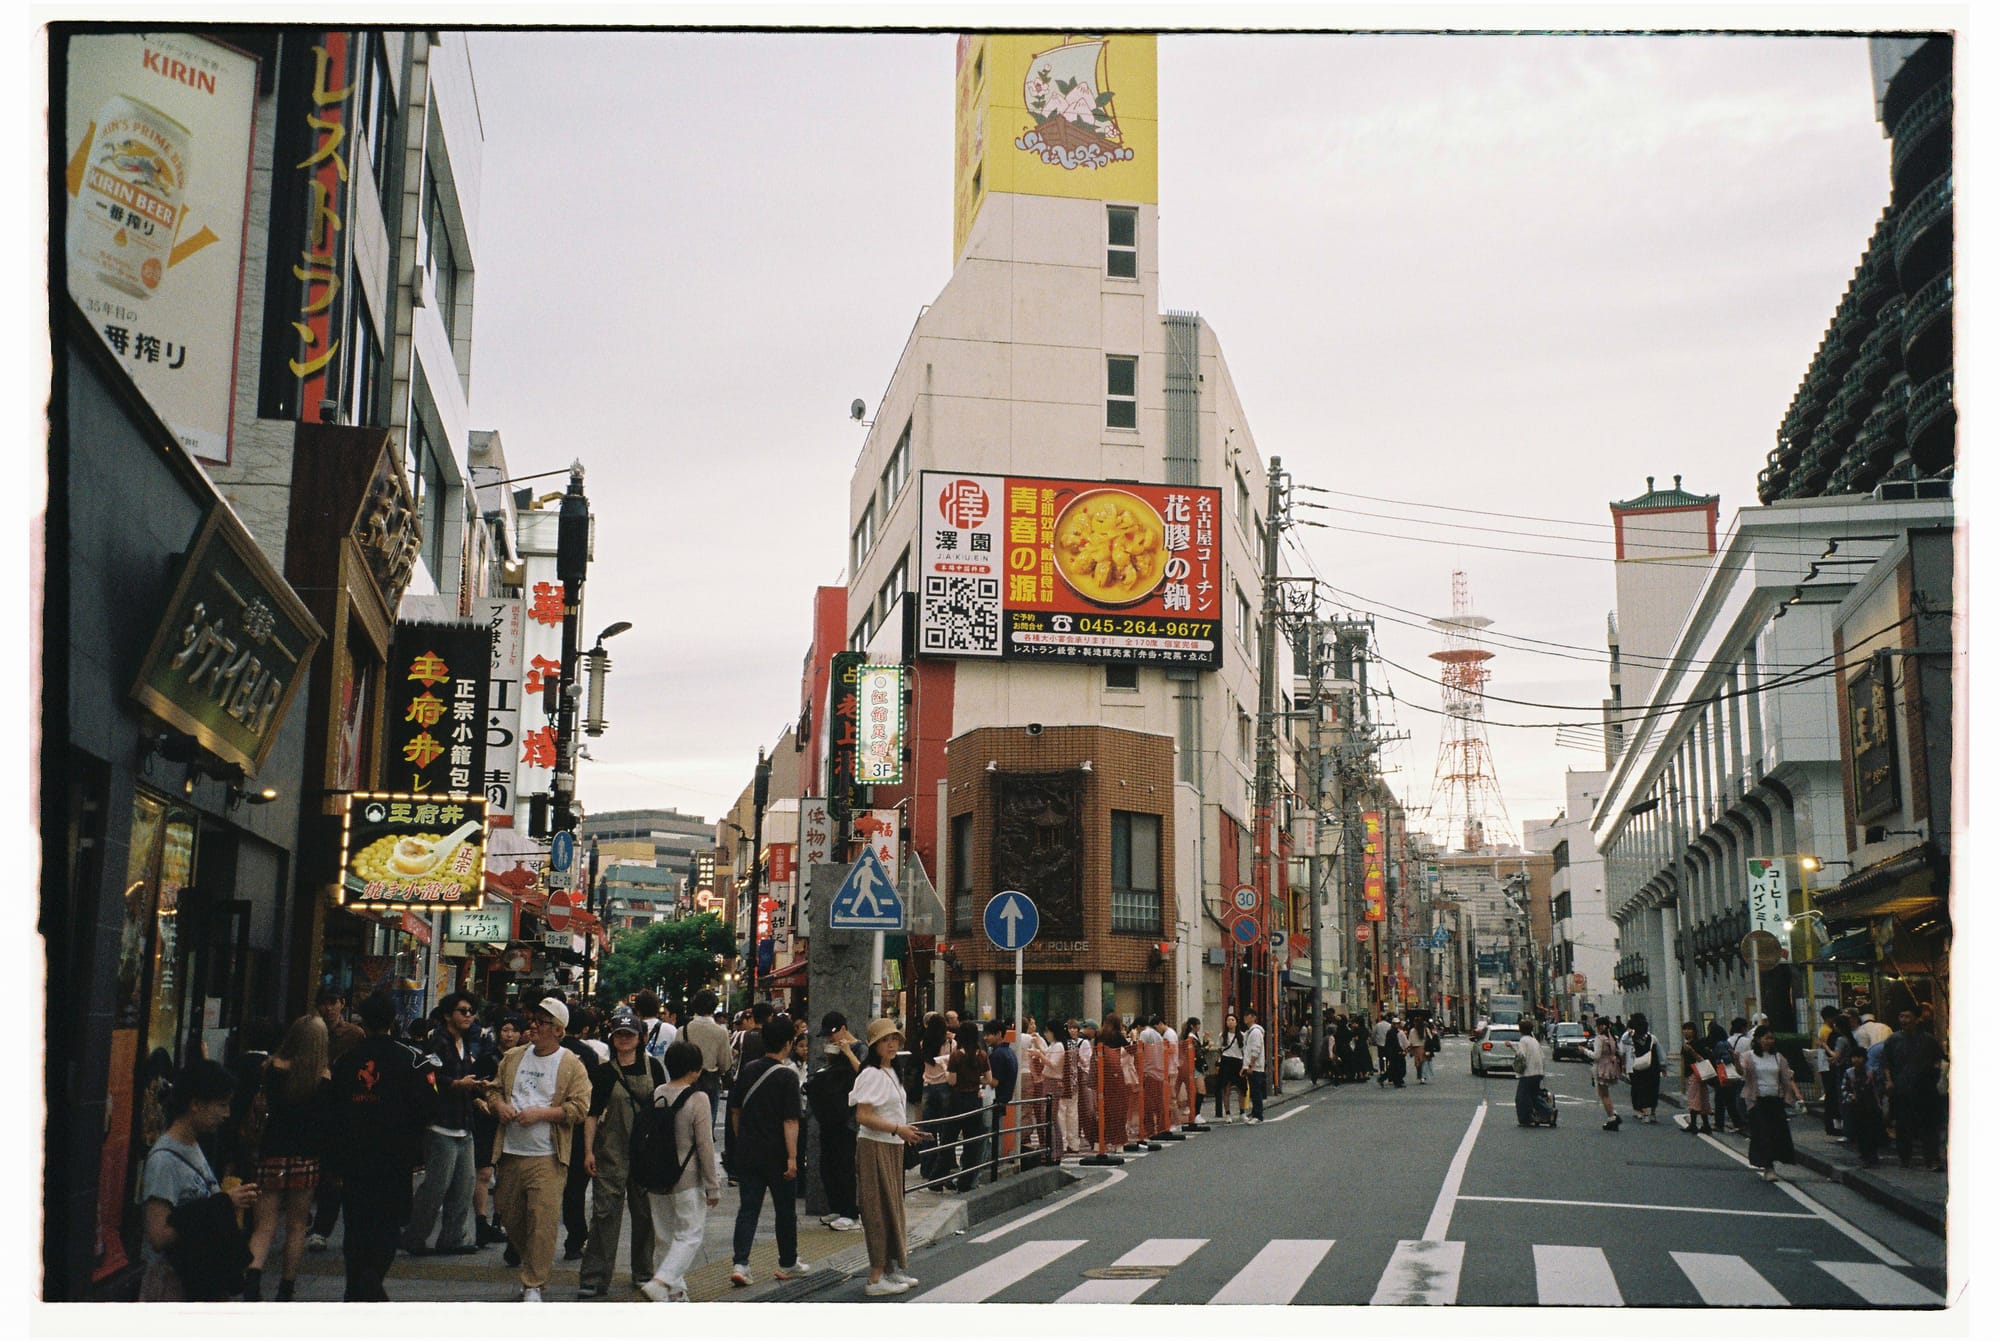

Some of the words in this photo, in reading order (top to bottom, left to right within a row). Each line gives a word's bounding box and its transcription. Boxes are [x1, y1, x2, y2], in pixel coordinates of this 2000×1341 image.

[143, 48, 216, 95] KIRIN
[88, 169, 134, 203] KIRIN
[136, 194, 172, 224] BEER
[290, 46, 356, 378] レストラン
[1010, 486, 1037, 602] 青春の源
[1163, 494, 1191, 611] 花膠の鍋
[1196, 495, 1213, 612] 名古屋コーチン
[1079, 618, 1212, 637] 045-264-9677
[872, 763, 891, 777] 3F
[387, 803, 464, 825] 王府井
[454, 847, 473, 873] 正宗
[361, 880, 463, 901] 焼き小籠包
[1237, 892, 1255, 907] 30
[1769, 870, 1782, 909] コーヒー
[459, 922, 500, 937] 江戸清
[1048, 941, 1089, 951] POLICE
